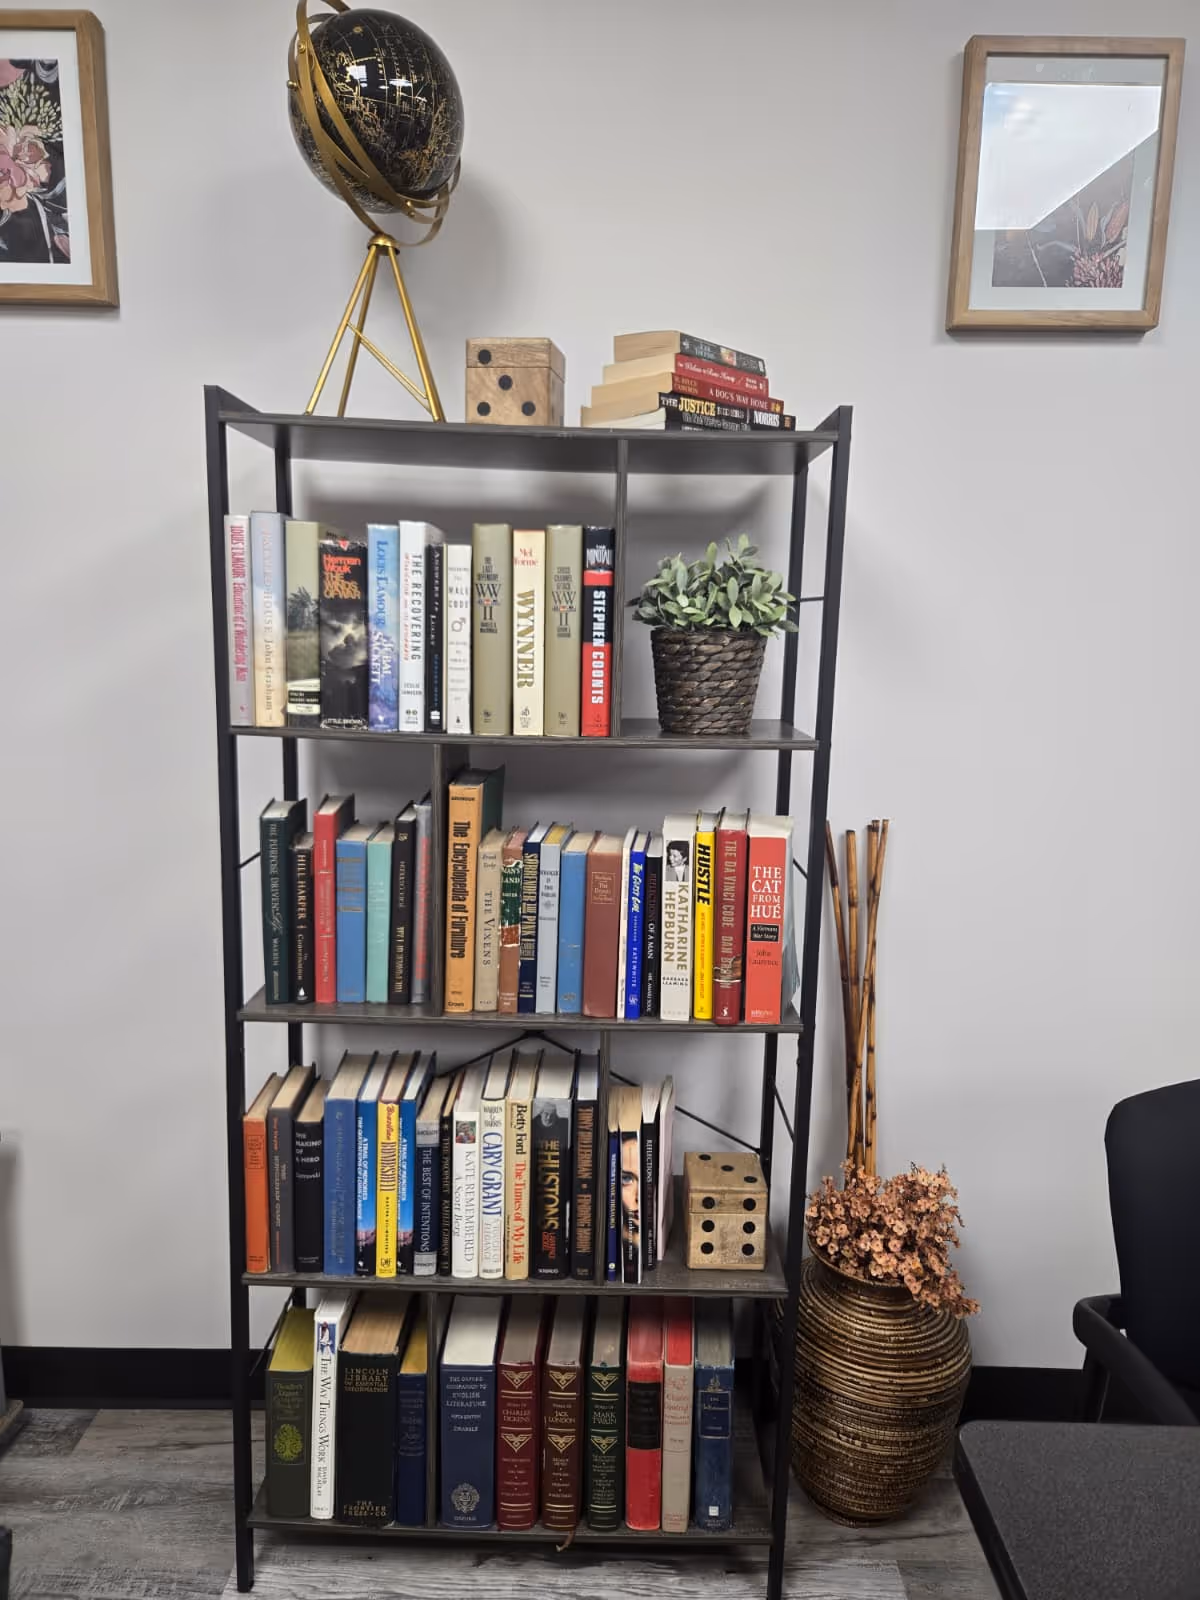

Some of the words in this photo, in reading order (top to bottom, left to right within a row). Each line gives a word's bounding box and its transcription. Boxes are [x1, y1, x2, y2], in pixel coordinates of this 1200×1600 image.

[660, 396, 678, 408] THE
[678, 396, 717, 417] JUSTICE
[709, 388, 714, 396] A
[715, 389, 735, 402] DOG'S
[736, 393, 749, 404] WAY
[750, 396, 769, 410] HOME
[753, 410, 780, 427] NORRIS
[230, 526, 244, 545] LOUIS
[231, 547, 245, 578] L'AMOUR
[376, 540, 389, 574] LOUIS
[412, 555, 422, 576] THE
[323, 571, 345, 581] THE
[323, 580, 359, 592] WINDS
[233, 583, 245, 614] Education
[323, 590, 337, 599] OF
[376, 576, 389, 625] L'AMOUR
[448, 586, 469, 595] MALE
[475, 583, 501, 598] WW
[552, 591, 576, 605] WW
[263, 591, 272, 633] HOUSE
[448, 600, 469, 609] CODE
[483, 606, 493, 620] II
[411, 583, 422, 661] RECOVERING
[560, 612, 569, 626] II
[592, 590, 605, 646] STEPHEN
[234, 630, 248, 665] Wandering
[516, 589, 535, 688] WYNNER
[264, 639, 274, 663] John
[371, 631, 382, 684] SACKETT
[381, 640, 392, 675] JUBAL
[236, 668, 248, 681] Man
[592, 651, 604, 704] COONTS
[265, 666, 274, 710] Grisham
[453, 821, 470, 838] The
[270, 839, 278, 874] PURPOSE
[724, 841, 737, 857] THE
[297, 855, 305, 877] HILL
[451, 843, 470, 902] Encyclopedia
[522, 853, 537, 901] SURRENDER
[697, 843, 711, 905] HUSTLE
[724, 861, 735, 872] DA
[752, 866, 782, 879] THE
[722, 876, 736, 900] VINCI
[751, 879, 782, 893] CAT
[297, 881, 306, 919] HARPER
[452, 904, 468, 913] of
[484, 891, 493, 915] THE
[752, 894, 781, 903] FROM
[722, 905, 732, 928] CODE
[750, 903, 782, 919] HUÉ
[450, 916, 468, 958] Furniture
[521, 916, 536, 936] PINK
[647, 923, 655, 934] OF
[664, 891, 675, 962] HEPBURN
[676, 884, 688, 971] KATHARINE
[483, 917, 495, 966] VIXENS
[721, 936, 732, 953] DAN
[386, 1105, 395, 1140] Brazilian
[515, 1104, 527, 1130] Betty
[577, 1107, 593, 1130] TONY
[482, 1132, 503, 1168] CARY
[515, 1133, 527, 1155] Ford
[577, 1132, 593, 1178] HILLERMAN
[363, 1160, 368, 1169] OF
[379, 1142, 396, 1191] BOMBSHELL
[402, 1160, 406, 1169] OF
[422, 1148, 432, 1164] THE
[465, 1151, 475, 1180] KATE
[422, 1167, 431, 1187] BEST
[515, 1160, 526, 1179] The
[422, 1189, 431, 1200] OF
[482, 1171, 502, 1217] GRANT
[514, 1181, 526, 1210] Times
[542, 1152, 560, 1229] HUSTONS
[514, 1211, 525, 1221] of
[577, 1194, 592, 1227] FINDING
[420, 1202, 430, 1252] INTENTIONS
[464, 1183, 474, 1262] REMEMBERED
[512, 1226, 525, 1242] My
[576, 1228, 592, 1253] MOON
[513, 1244, 524, 1264] Life
[321, 1357, 331, 1374] THE
[320, 1376, 331, 1399] WAY
[345, 1374, 389, 1382] LIBRARY
[319, 1400, 331, 1434] THINGS
[318, 1435, 328, 1463] WORK
